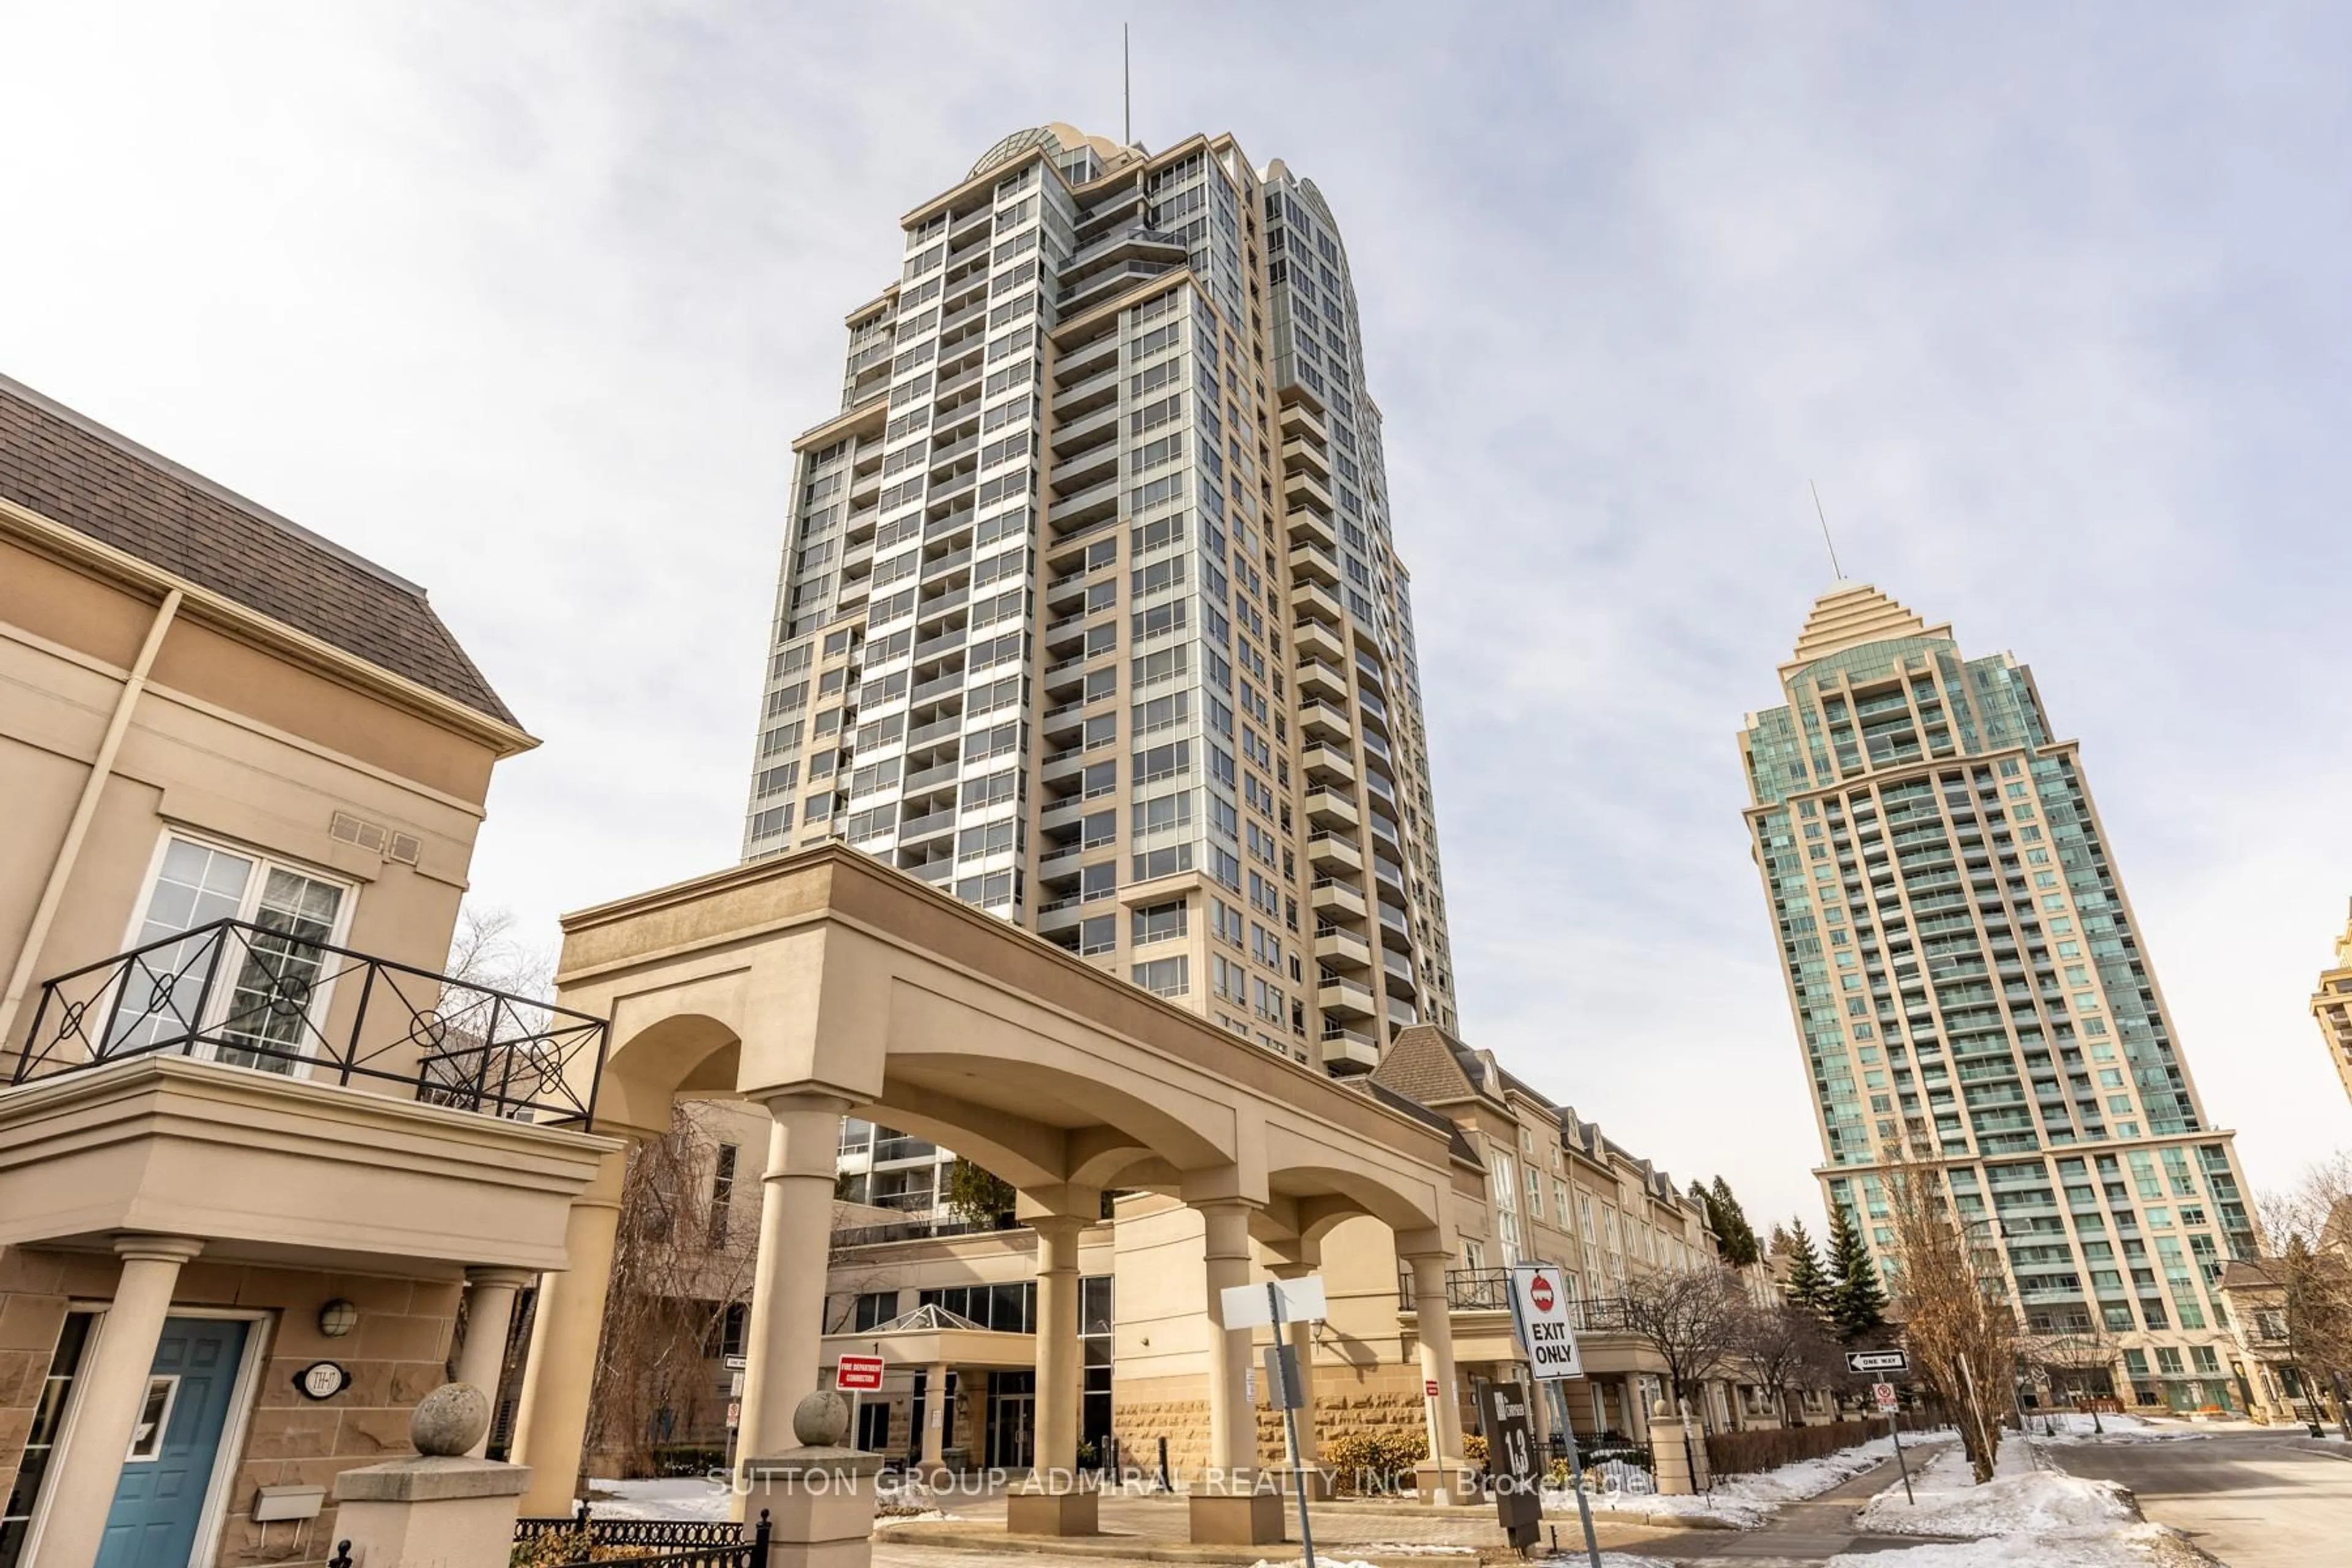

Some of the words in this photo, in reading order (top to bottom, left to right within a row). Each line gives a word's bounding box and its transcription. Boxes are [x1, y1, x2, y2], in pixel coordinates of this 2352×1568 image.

[1532, 1322, 1565, 1340] EXIT
[1536, 1344, 1571, 1364] ONLY
[846, 1374, 875, 1382] CONNECTION
